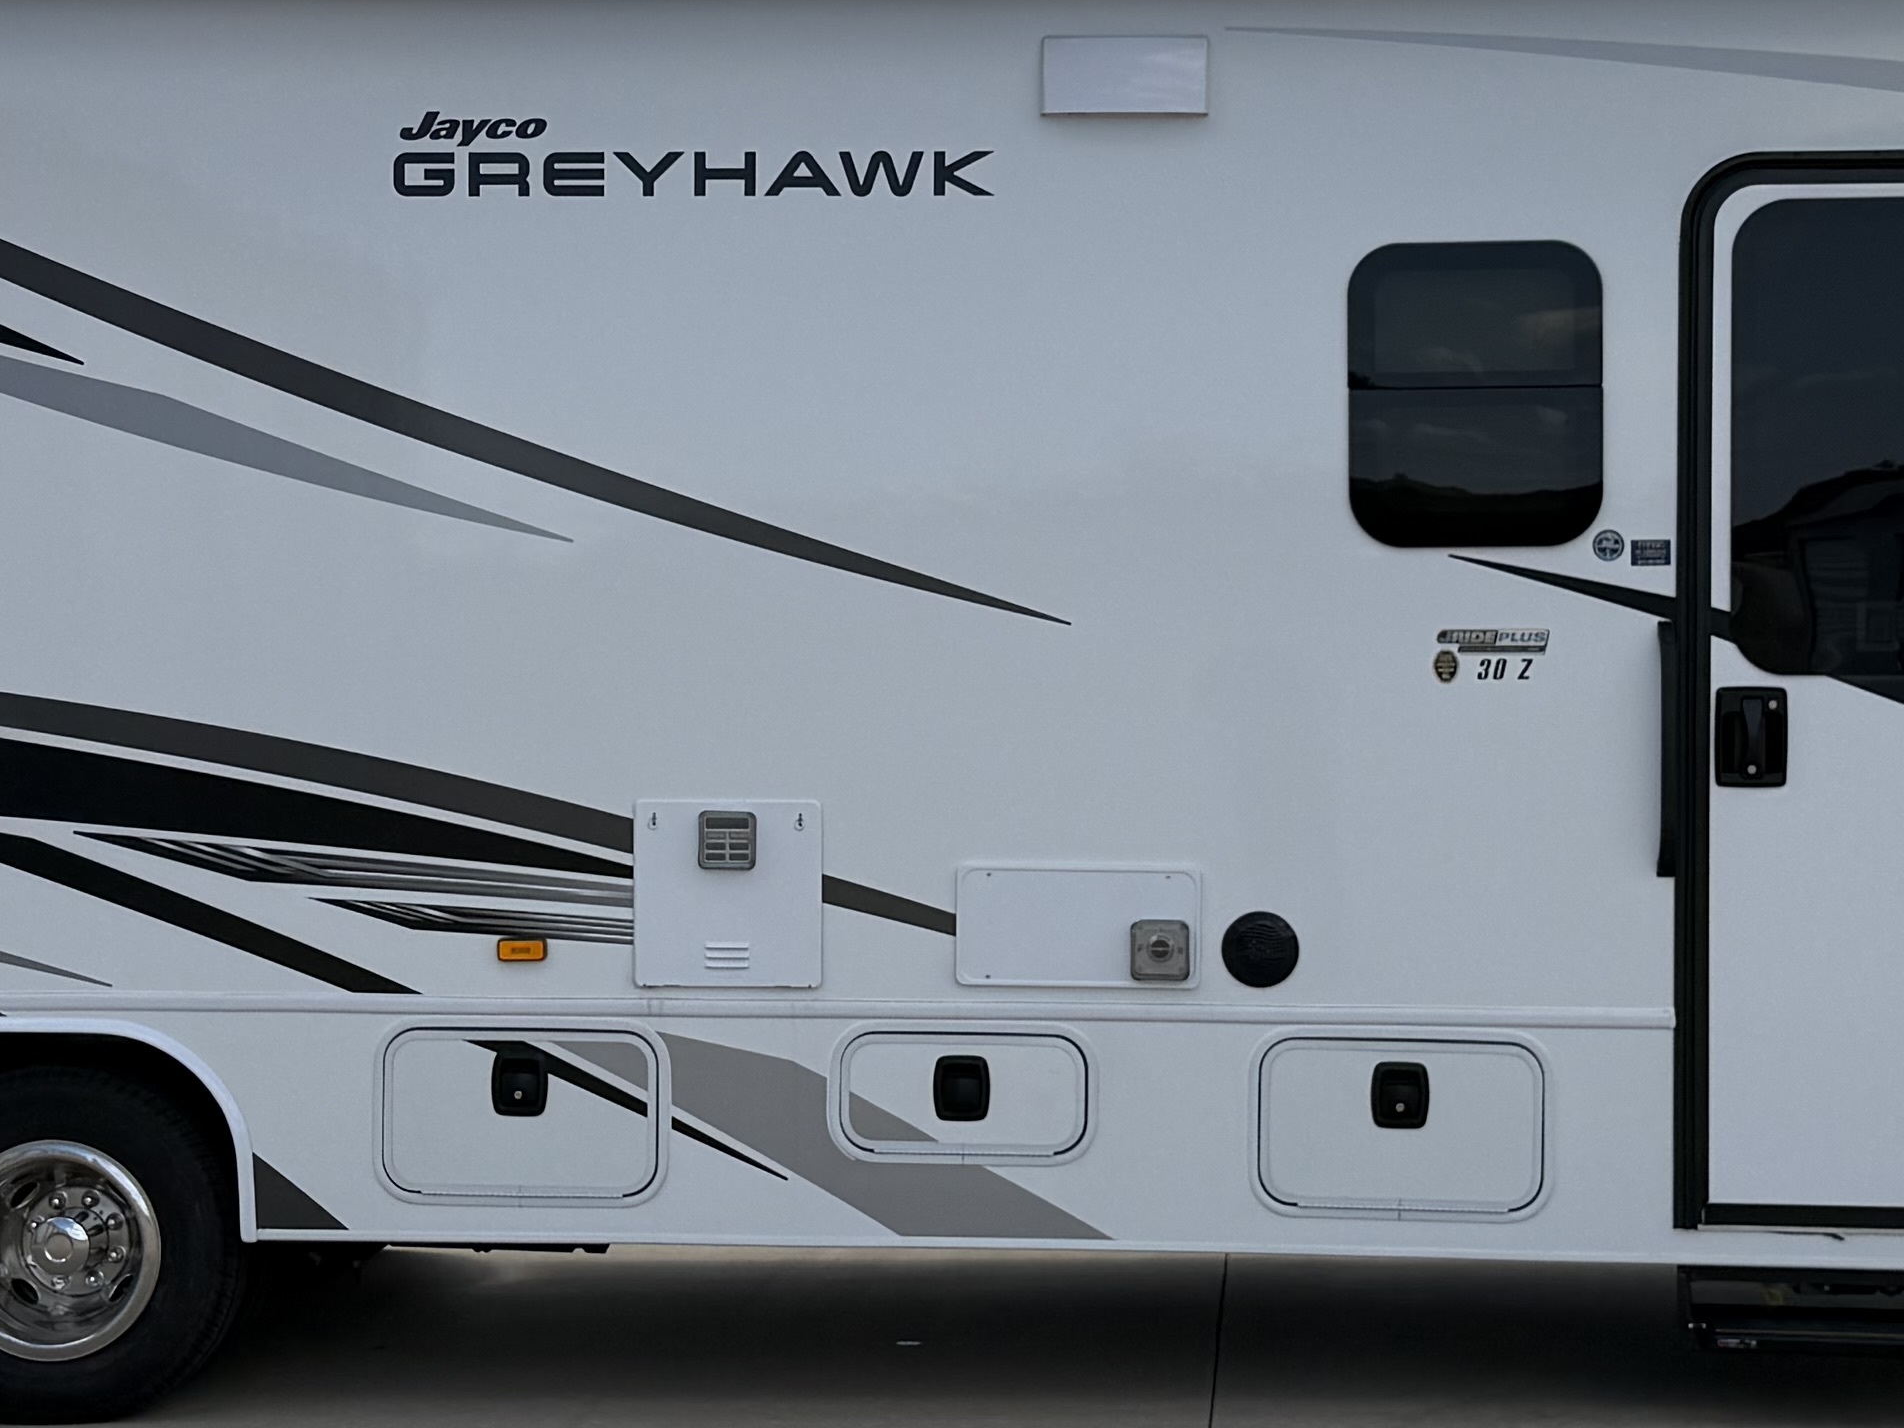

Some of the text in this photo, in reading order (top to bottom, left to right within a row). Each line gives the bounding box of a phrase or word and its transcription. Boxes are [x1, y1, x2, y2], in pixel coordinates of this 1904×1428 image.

[399, 111, 547, 147] Jayco
[393, 150, 995, 197] GREYHAWK
[1498, 632, 1546, 643] PLUS
[1477, 658, 1507, 680] 30
[1517, 658, 1534, 680] Z
